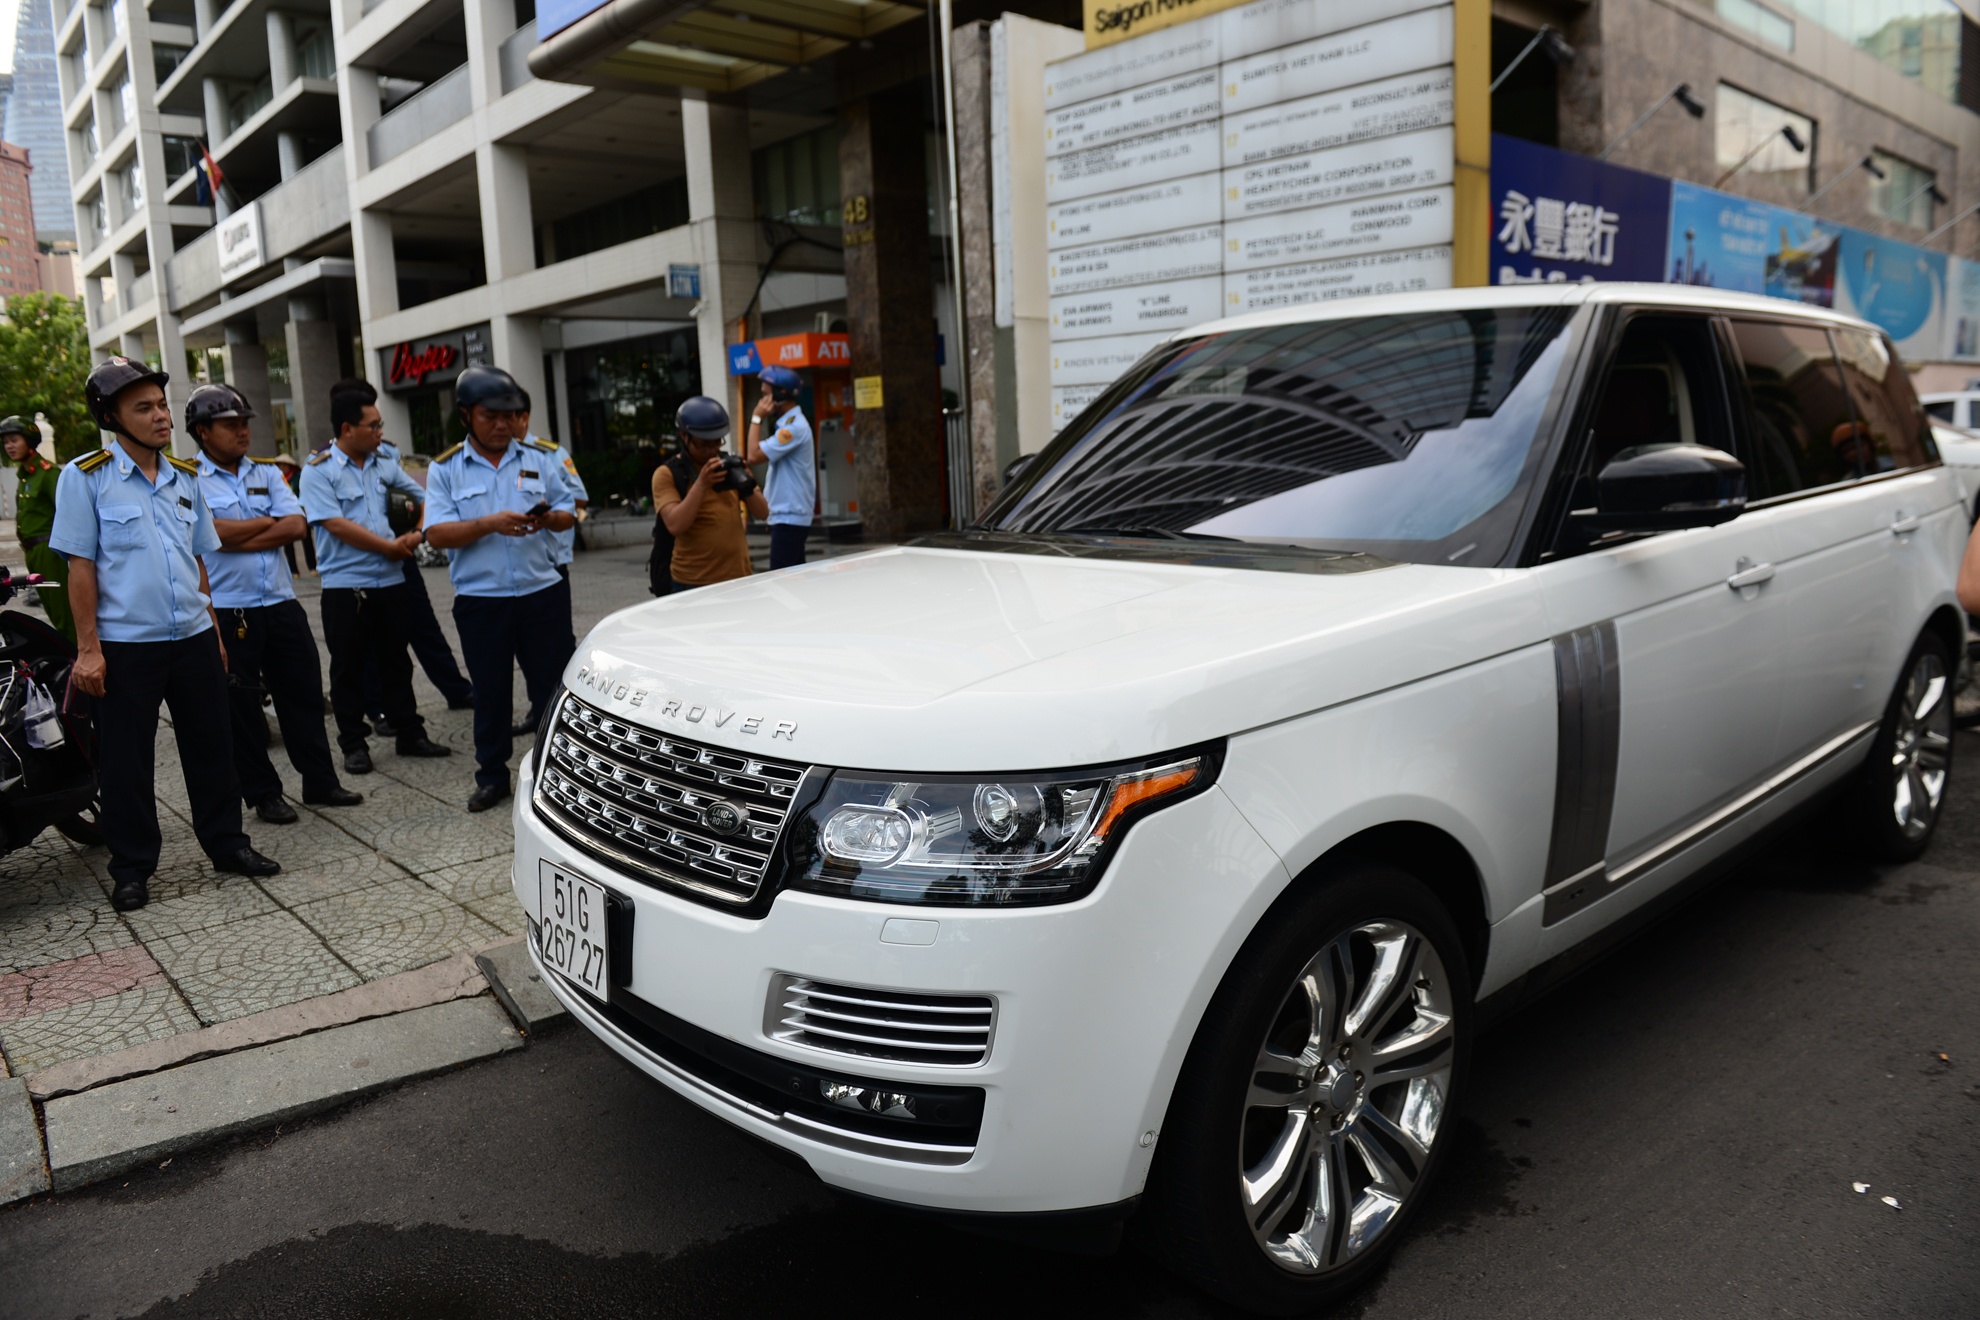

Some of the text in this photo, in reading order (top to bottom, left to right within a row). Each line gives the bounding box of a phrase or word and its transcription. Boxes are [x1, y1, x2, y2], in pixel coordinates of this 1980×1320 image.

[1094, 2, 1153, 34] Saigon
[1324, 156, 1412, 184] CORPORATION
[1498, 190, 1619, 266] 永豐銀行
[1079, 301, 1113, 315] AIRWAYS
[1078, 314, 1112, 327] AIRWAYS
[734, 355, 751, 370] VIB
[780, 342, 804, 361] ATM
[577, 665, 798, 741] RANGE ROVER
[711, 817, 733, 829] ROVER
[712, 808, 730, 819] LAND
[554, 872, 589, 933] 51G
[543, 916, 604, 991] 267.27
